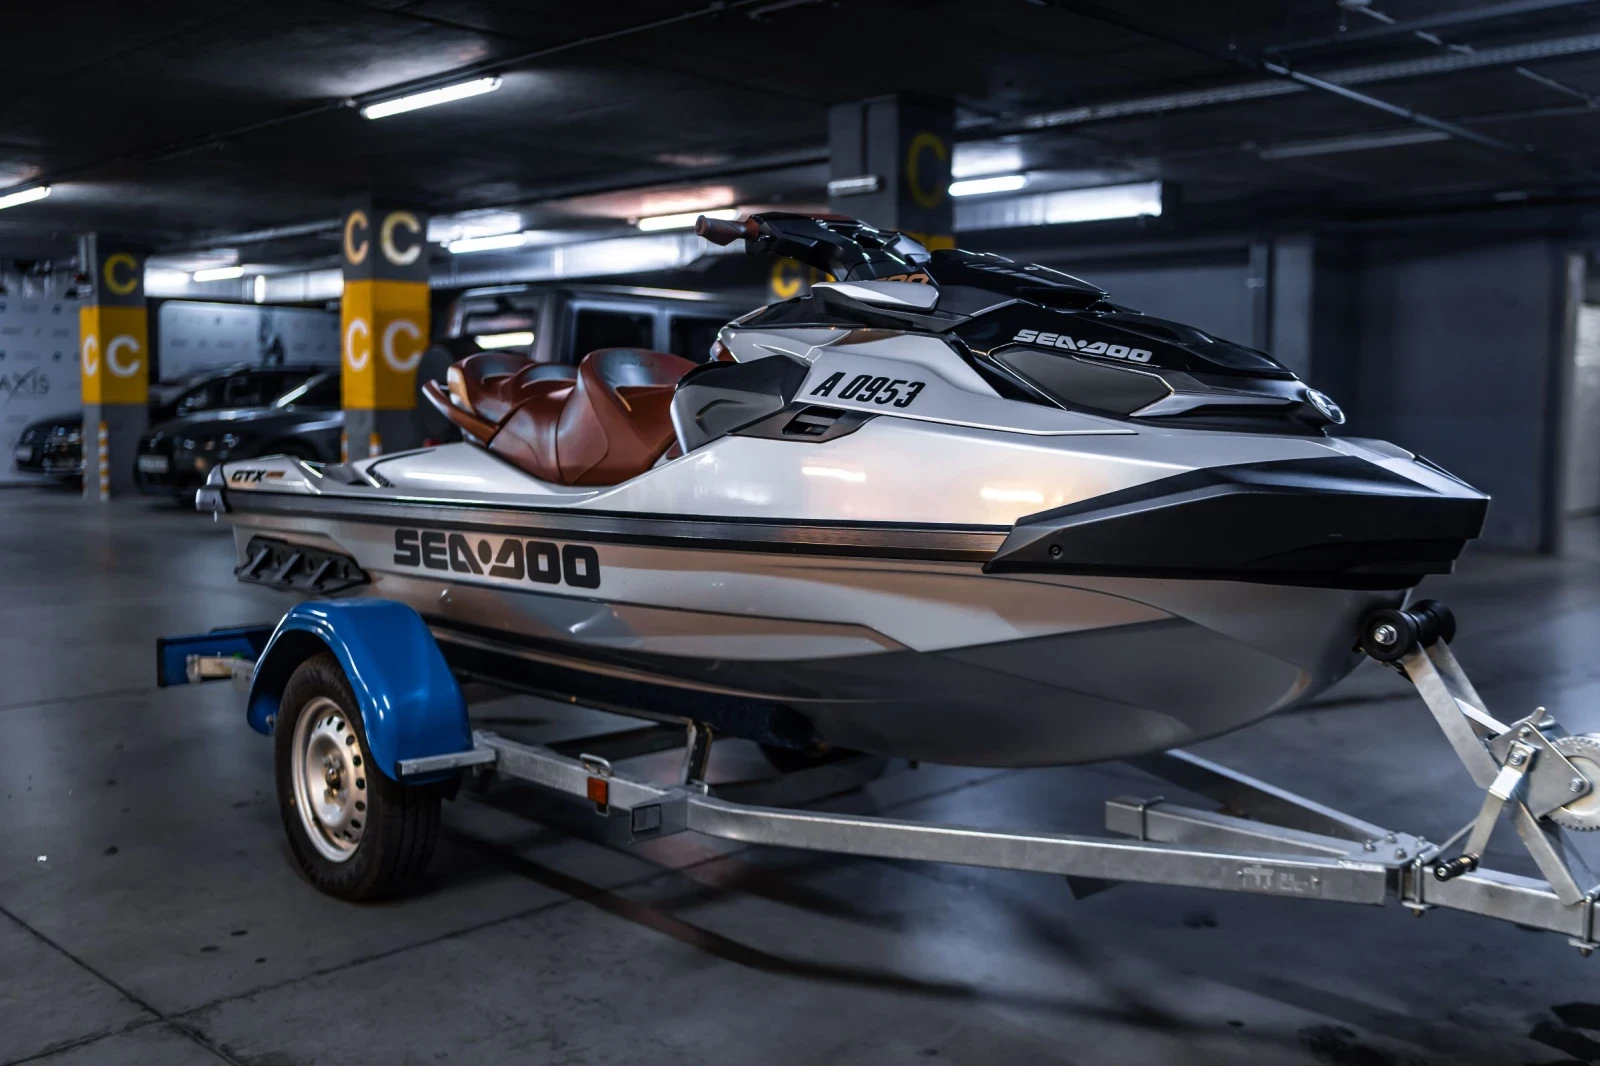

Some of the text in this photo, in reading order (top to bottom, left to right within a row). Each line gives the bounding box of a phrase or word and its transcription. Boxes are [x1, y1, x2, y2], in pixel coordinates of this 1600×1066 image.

[907, 133, 948, 207] C
[344, 210, 370, 265] C
[380, 211, 422, 266] C
[103, 253, 138, 295] C
[771, 256, 801, 298] C
[83, 334, 98, 377] C
[106, 335, 141, 377] C
[346, 318, 369, 373] C
[382, 319, 422, 373] C
[809, 371, 926, 408] A 0953
[231, 469, 266, 482] GTX
